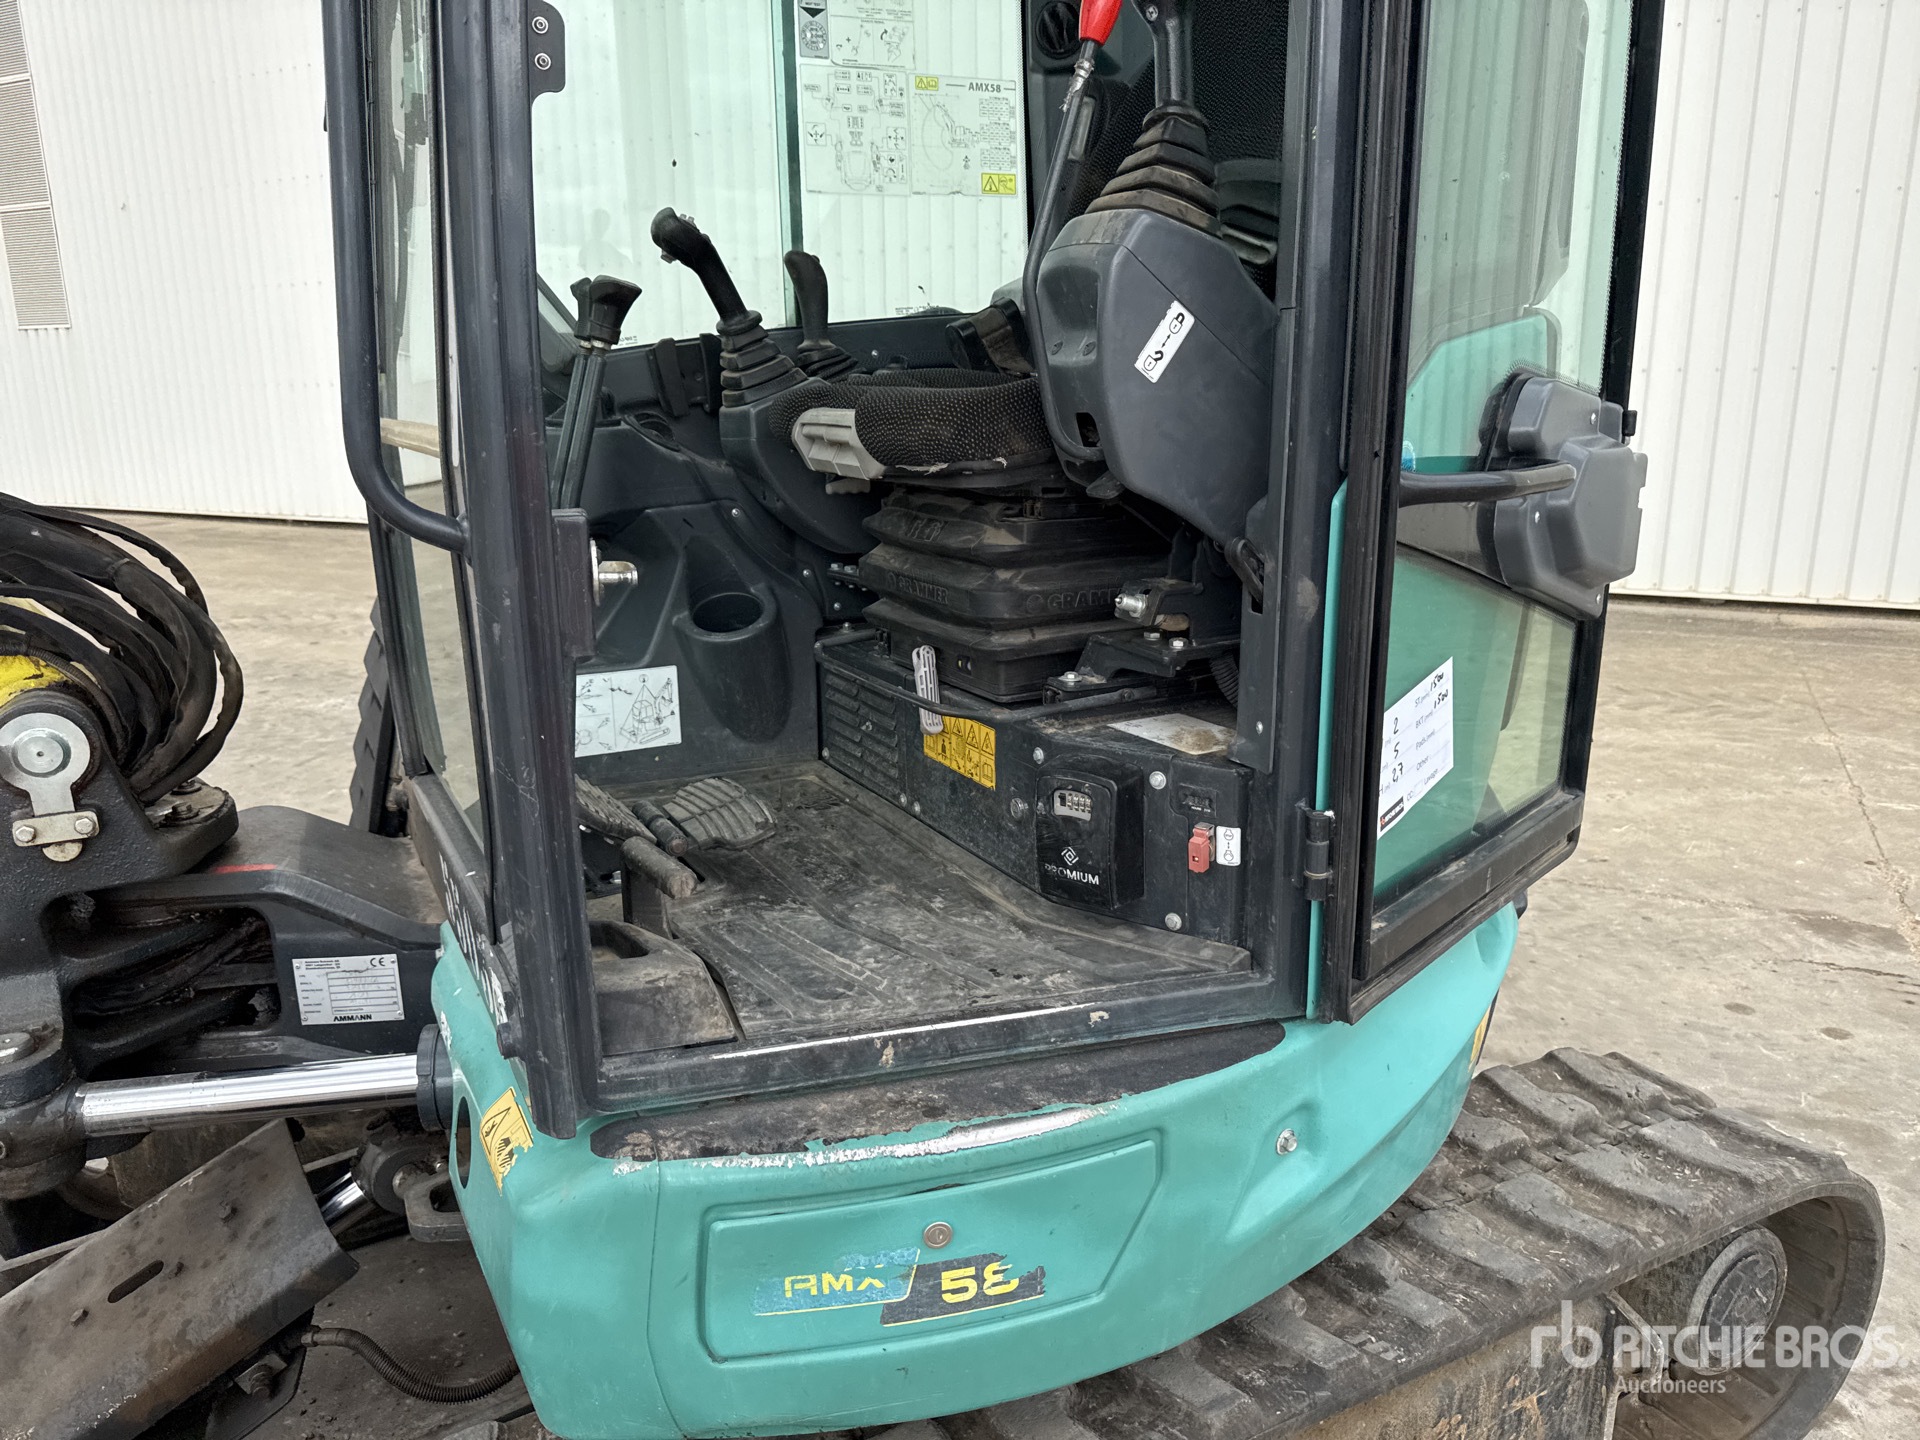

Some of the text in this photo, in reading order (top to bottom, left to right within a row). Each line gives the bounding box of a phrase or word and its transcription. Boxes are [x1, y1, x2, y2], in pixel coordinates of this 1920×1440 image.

[968, 81, 1001, 93] AMX58
[1393, 716, 1400, 735] 2
[333, 1013, 373, 1022] AMMANN
